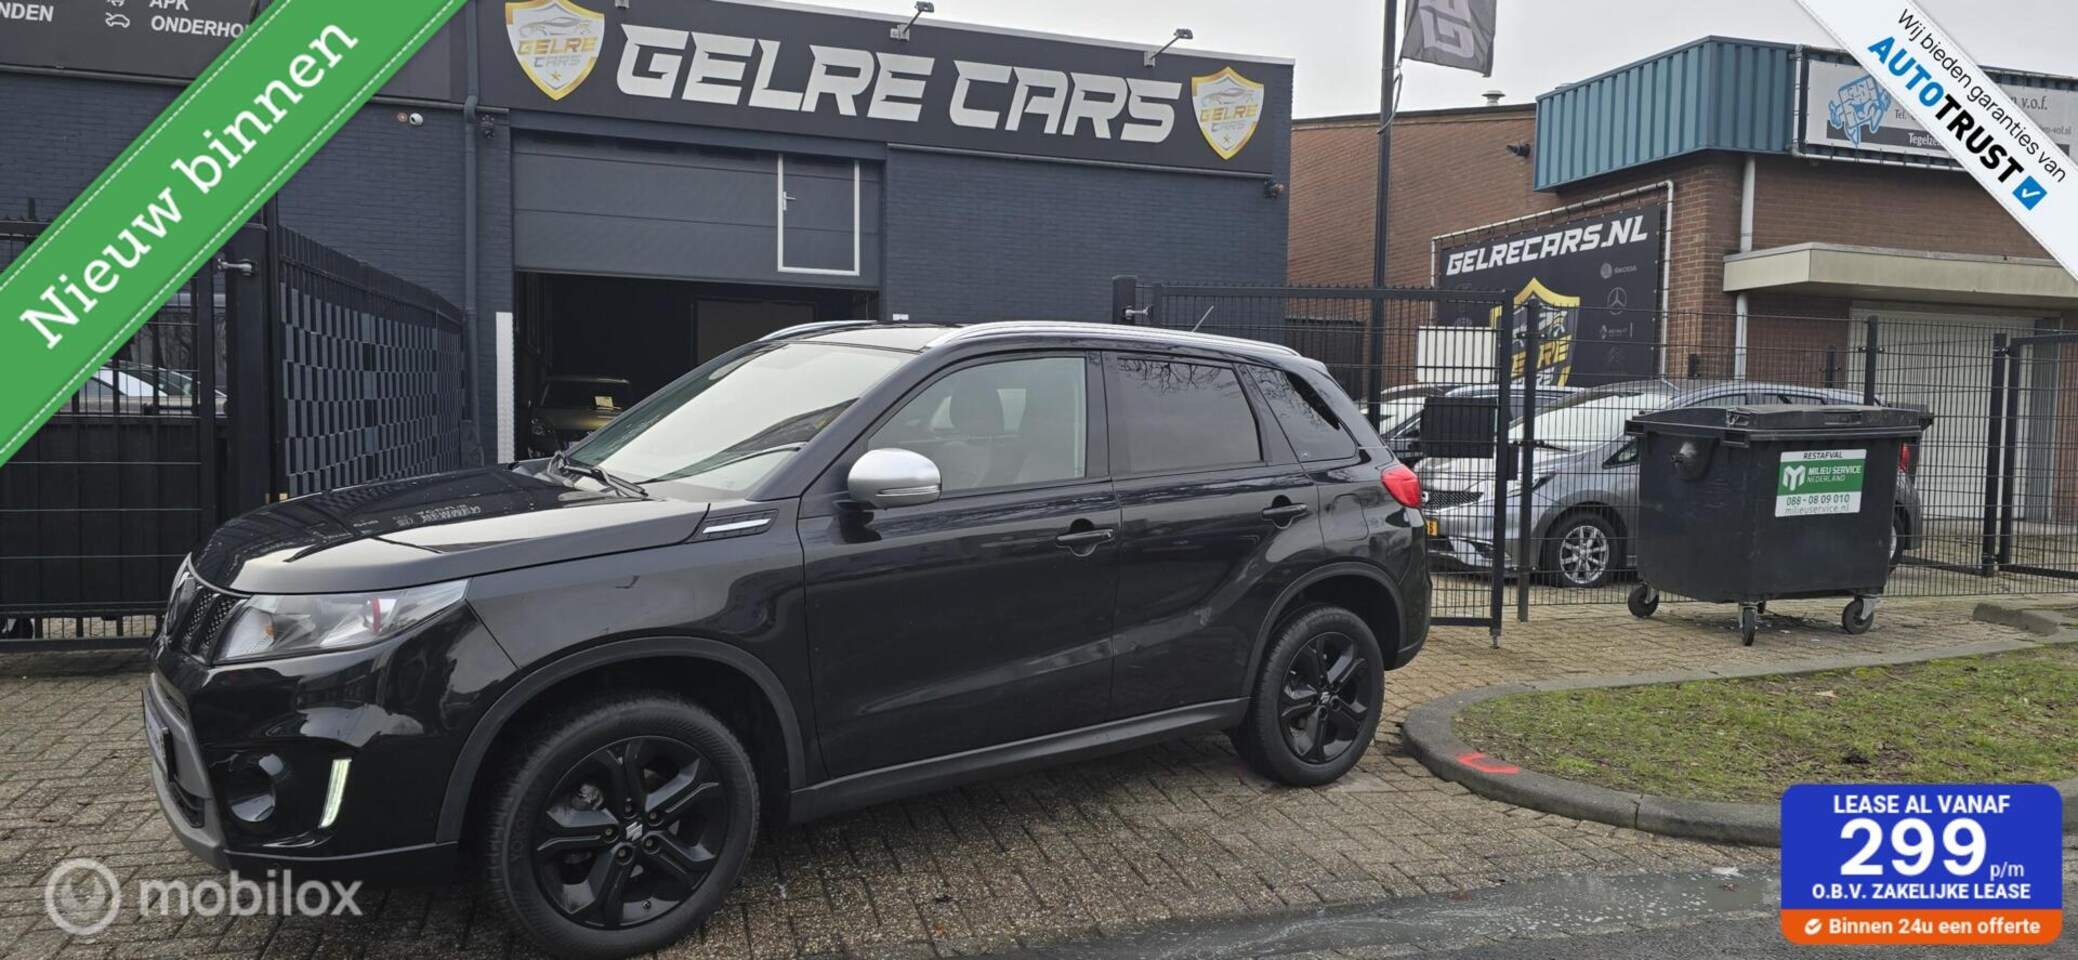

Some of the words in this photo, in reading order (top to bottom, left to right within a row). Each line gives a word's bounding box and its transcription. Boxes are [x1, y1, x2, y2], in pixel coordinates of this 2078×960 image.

[151, 15, 249, 38] ONDERHO
[517, 36, 598, 55] GELRE
[534, 55, 581, 67] CARS
[616, 23, 935, 122] GELRE
[949, 60, 1183, 143] CARS
[2022, 95, 2048, 110] v.o.f.
[1200, 104, 1259, 122] GELRE
[1446, 215, 1648, 276] GELRECARS.NL
[1803, 452, 1843, 460] RESTAFVAL
[1808, 467, 1832, 476] MILIEU
[1832, 465, 1862, 475] SERVICE
[1807, 474, 1846, 483] NEDERLAND
[1786, 496, 1801, 506] 088
[1808, 495, 1819, 505] 08
[1820, 494, 1831, 504] 09
[1833, 493, 1850, 503] 010
[1785, 504, 1850, 515] milieuservice.nl
